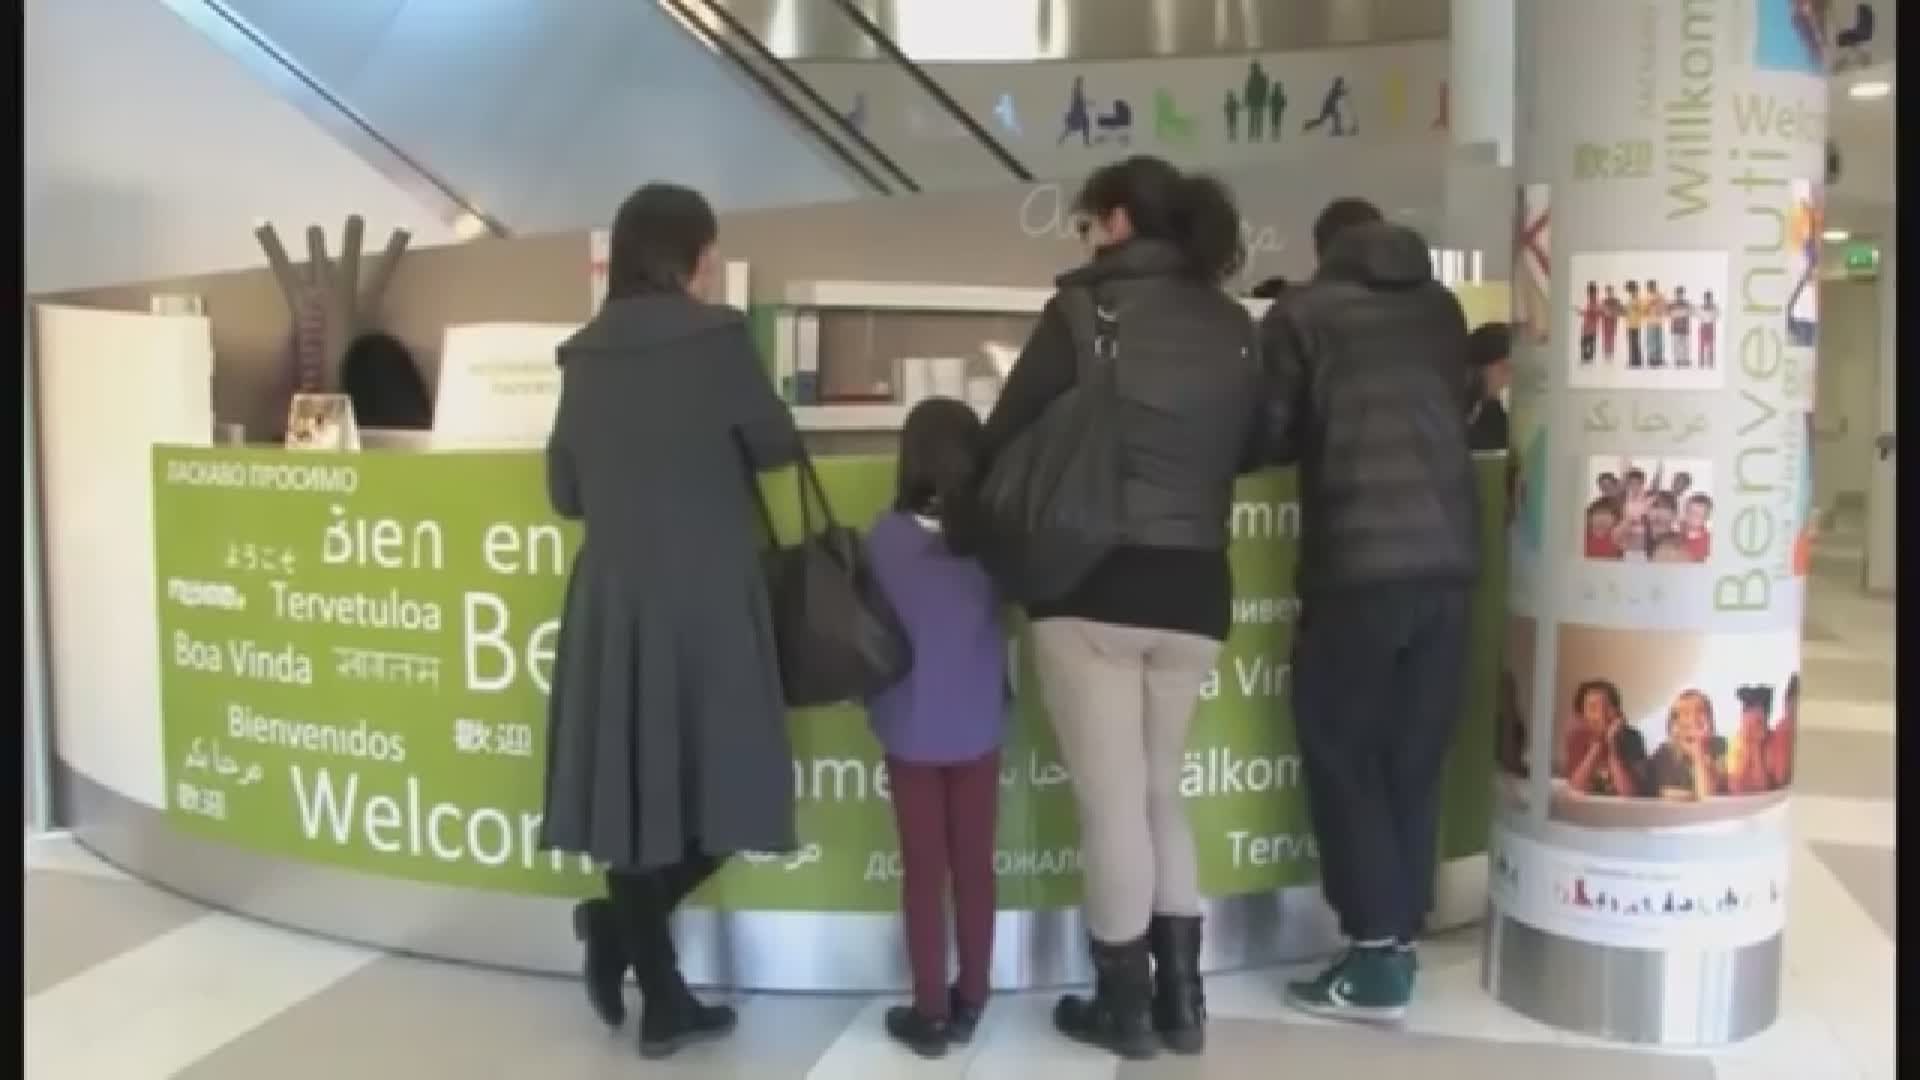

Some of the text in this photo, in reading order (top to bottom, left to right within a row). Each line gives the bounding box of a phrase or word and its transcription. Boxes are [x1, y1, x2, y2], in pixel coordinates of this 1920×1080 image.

[1713, 145, 1790, 612] Benvenuti
[269, 580, 442, 630] Tervetuloa
[174, 630, 313, 686] Boa Vinda
[227, 704, 406, 763] Bienvenidos
